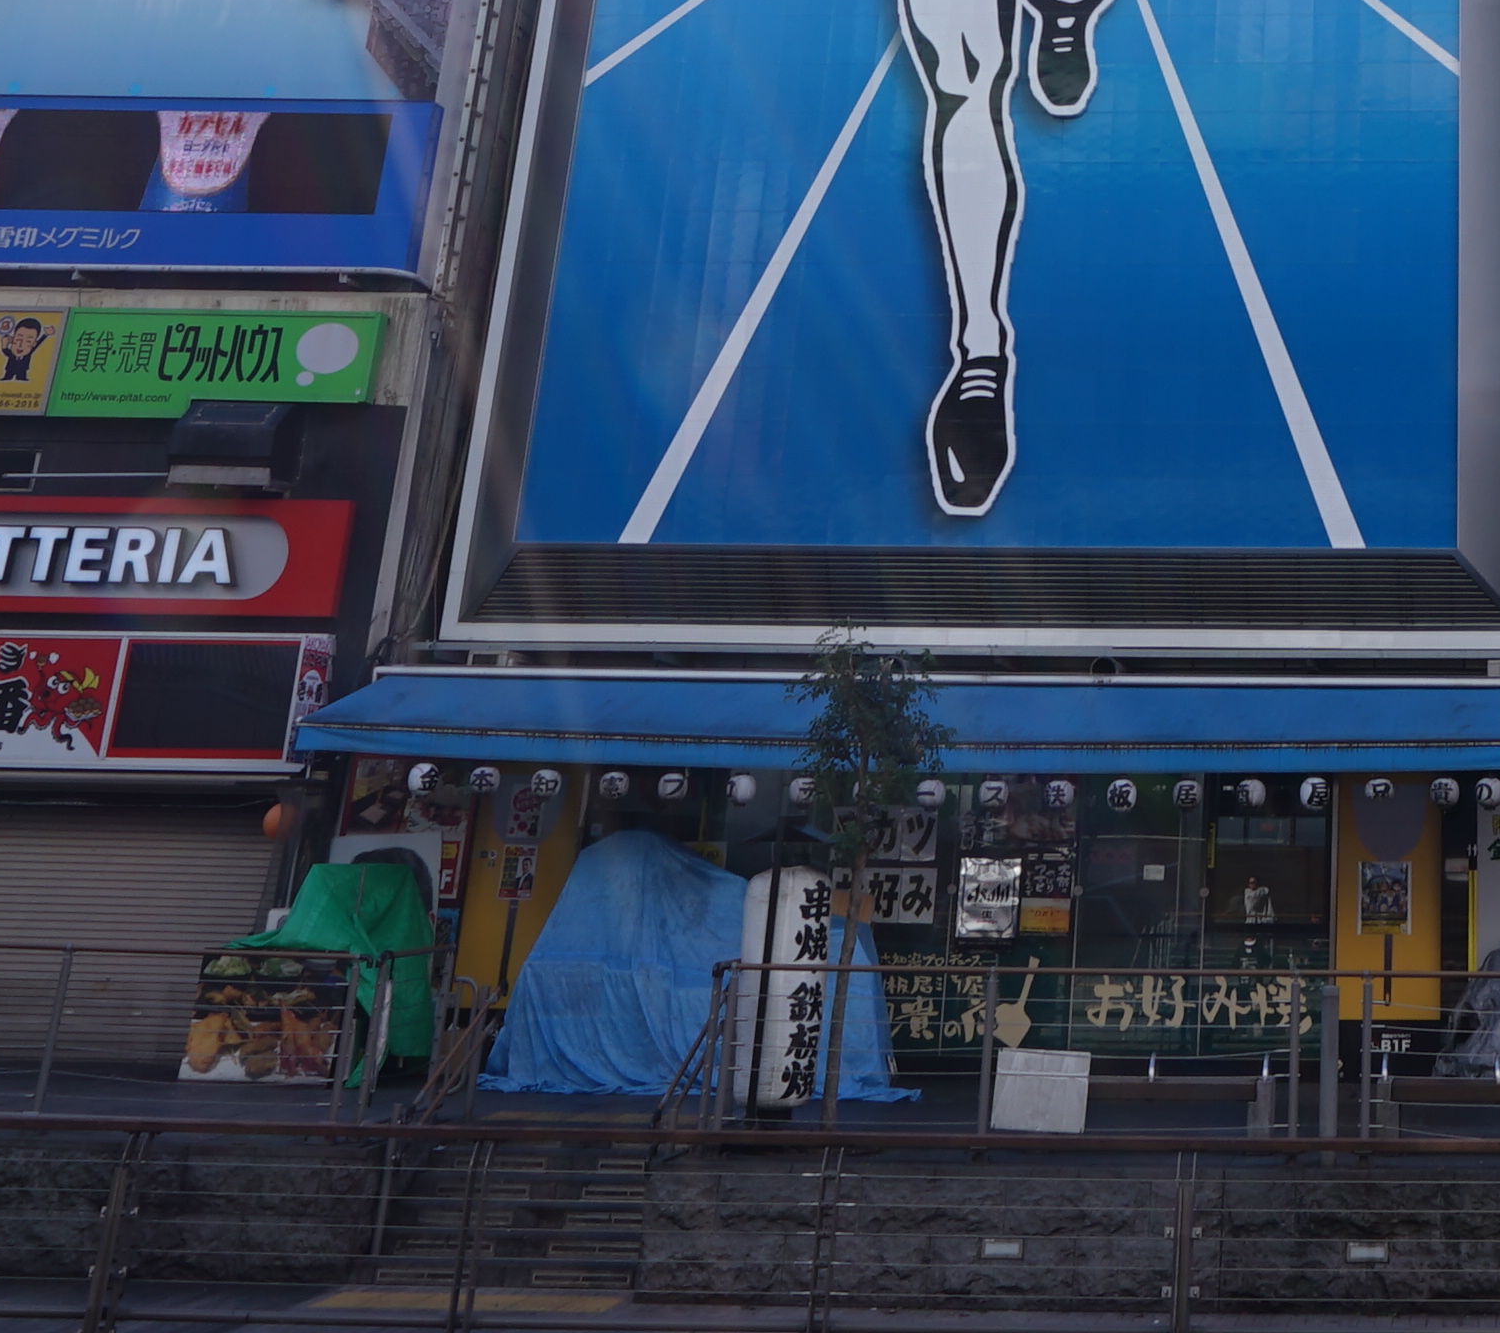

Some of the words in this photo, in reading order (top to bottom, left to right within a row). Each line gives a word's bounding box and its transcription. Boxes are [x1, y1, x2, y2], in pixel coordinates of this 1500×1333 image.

[71, 330, 157, 374] 賃貸・売買
[158, 323, 284, 384] ピタットハウス
[1381, 1038, 1411, 1053] B1F
